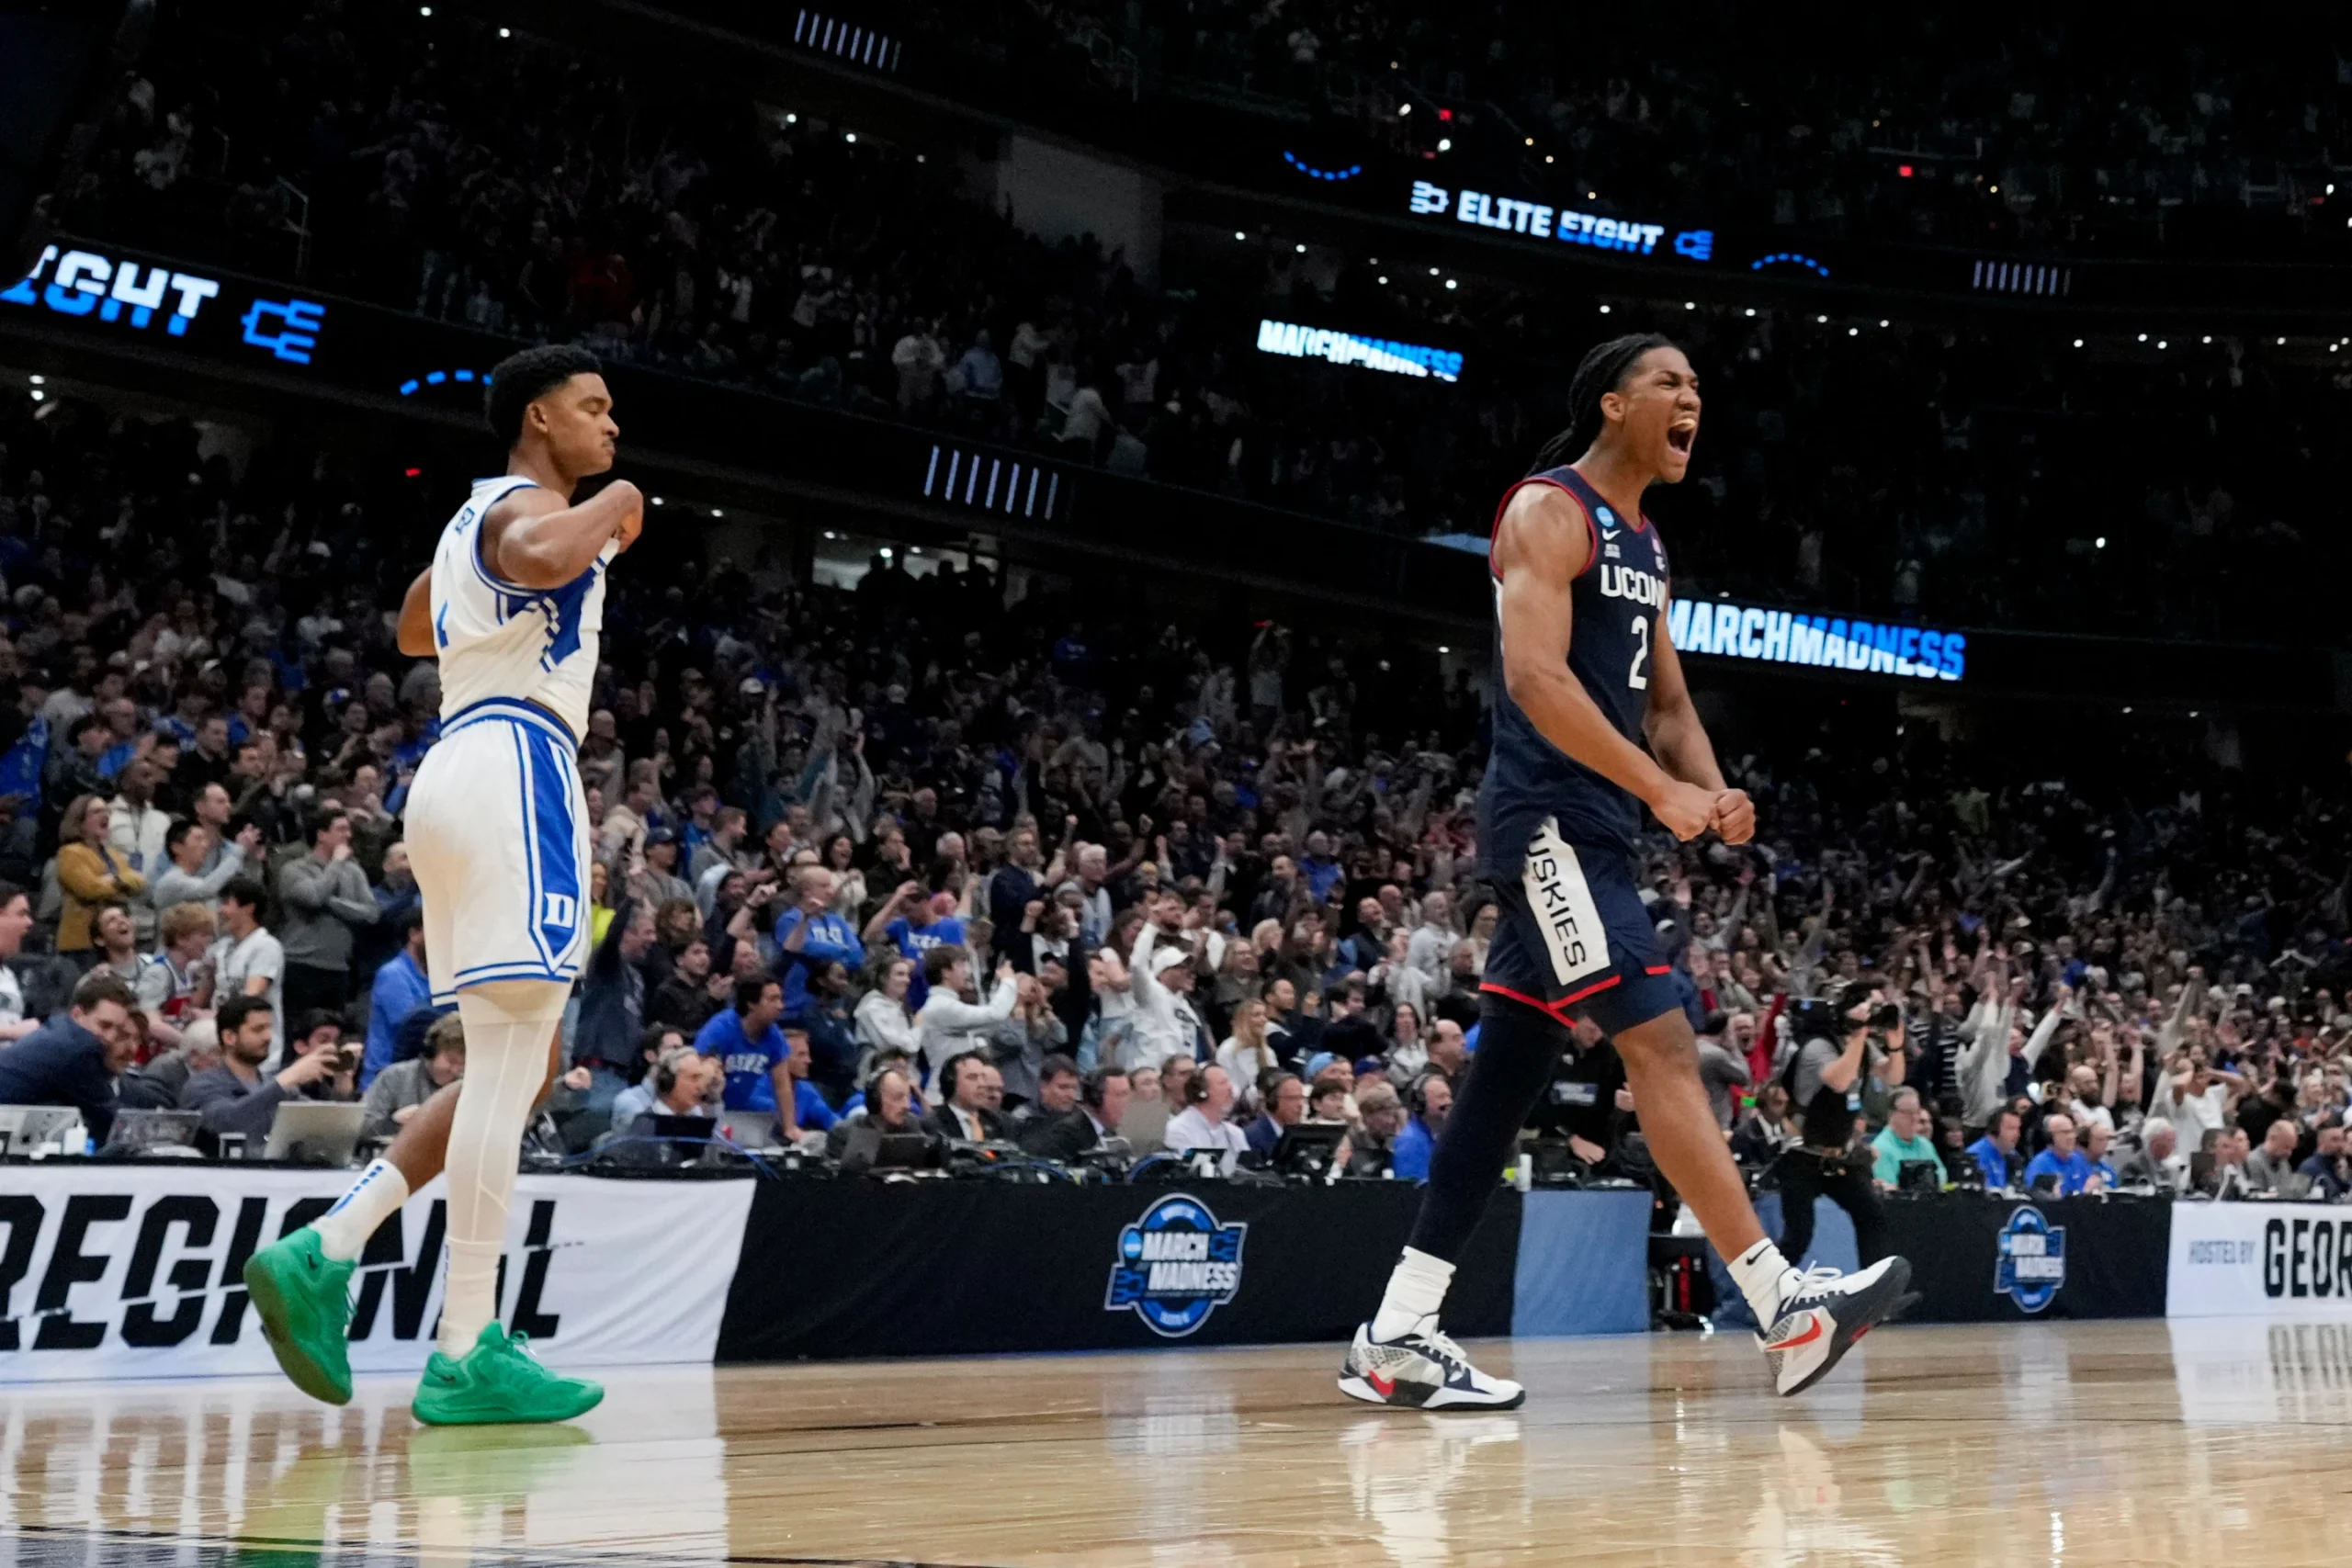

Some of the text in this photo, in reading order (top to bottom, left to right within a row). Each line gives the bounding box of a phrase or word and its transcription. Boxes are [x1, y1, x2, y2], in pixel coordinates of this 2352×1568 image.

[1457, 190, 1664, 254] ELITE EIGHT
[1628, 615, 1649, 690] 2
[542, 892, 576, 929] D
[1141, 1232, 1210, 1260] MARCH
[0, 1194, 561, 1351] REGINL
[1148, 1261, 1238, 1291] MADNESS
